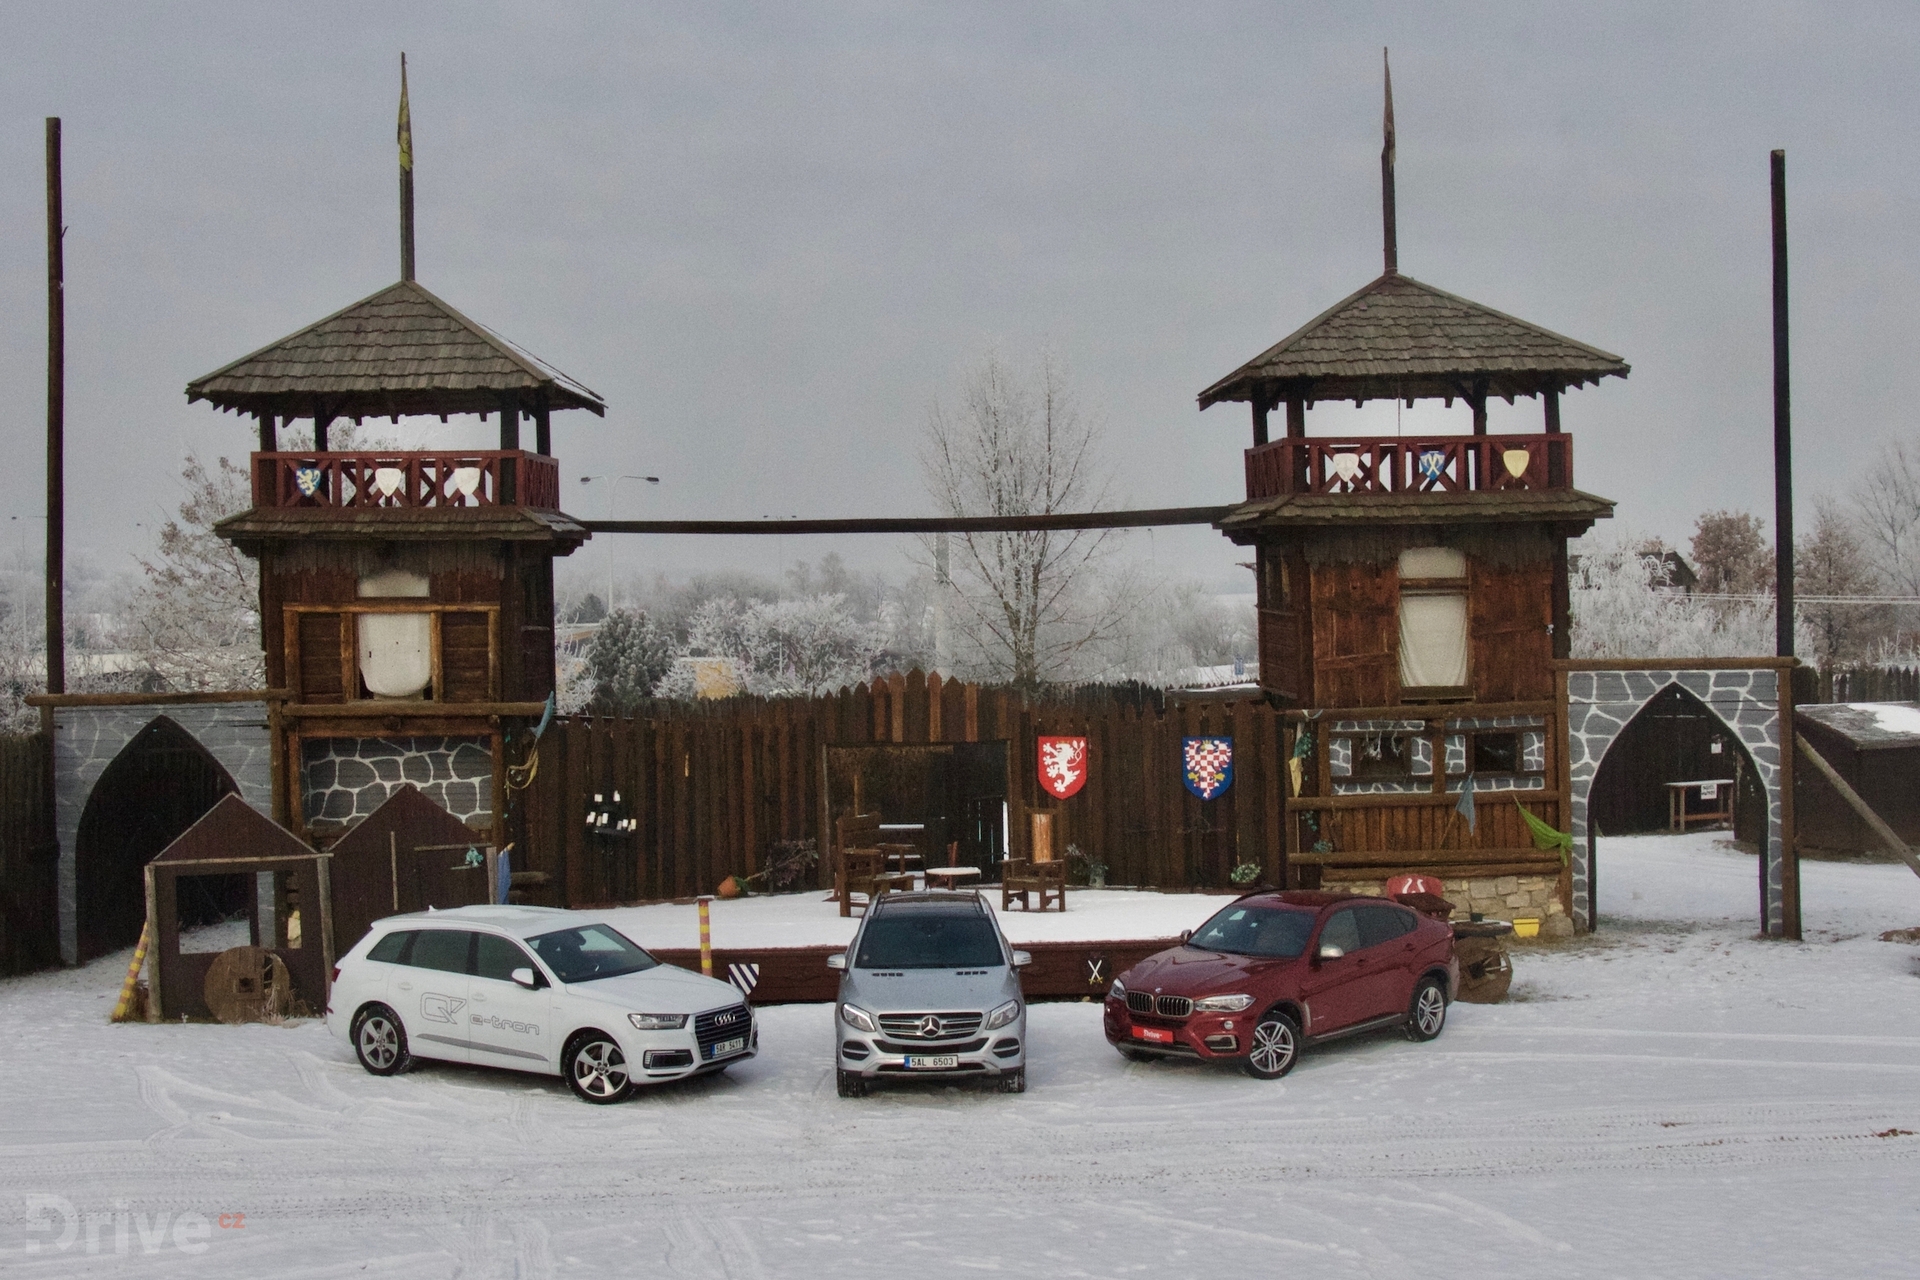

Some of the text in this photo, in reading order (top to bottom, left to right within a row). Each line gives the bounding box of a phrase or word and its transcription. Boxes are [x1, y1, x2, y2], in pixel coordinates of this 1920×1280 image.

[420, 992, 467, 1025] Q7
[470, 1014, 540, 1036] e-tron
[911, 1057, 954, 1067] 5AL 6503
